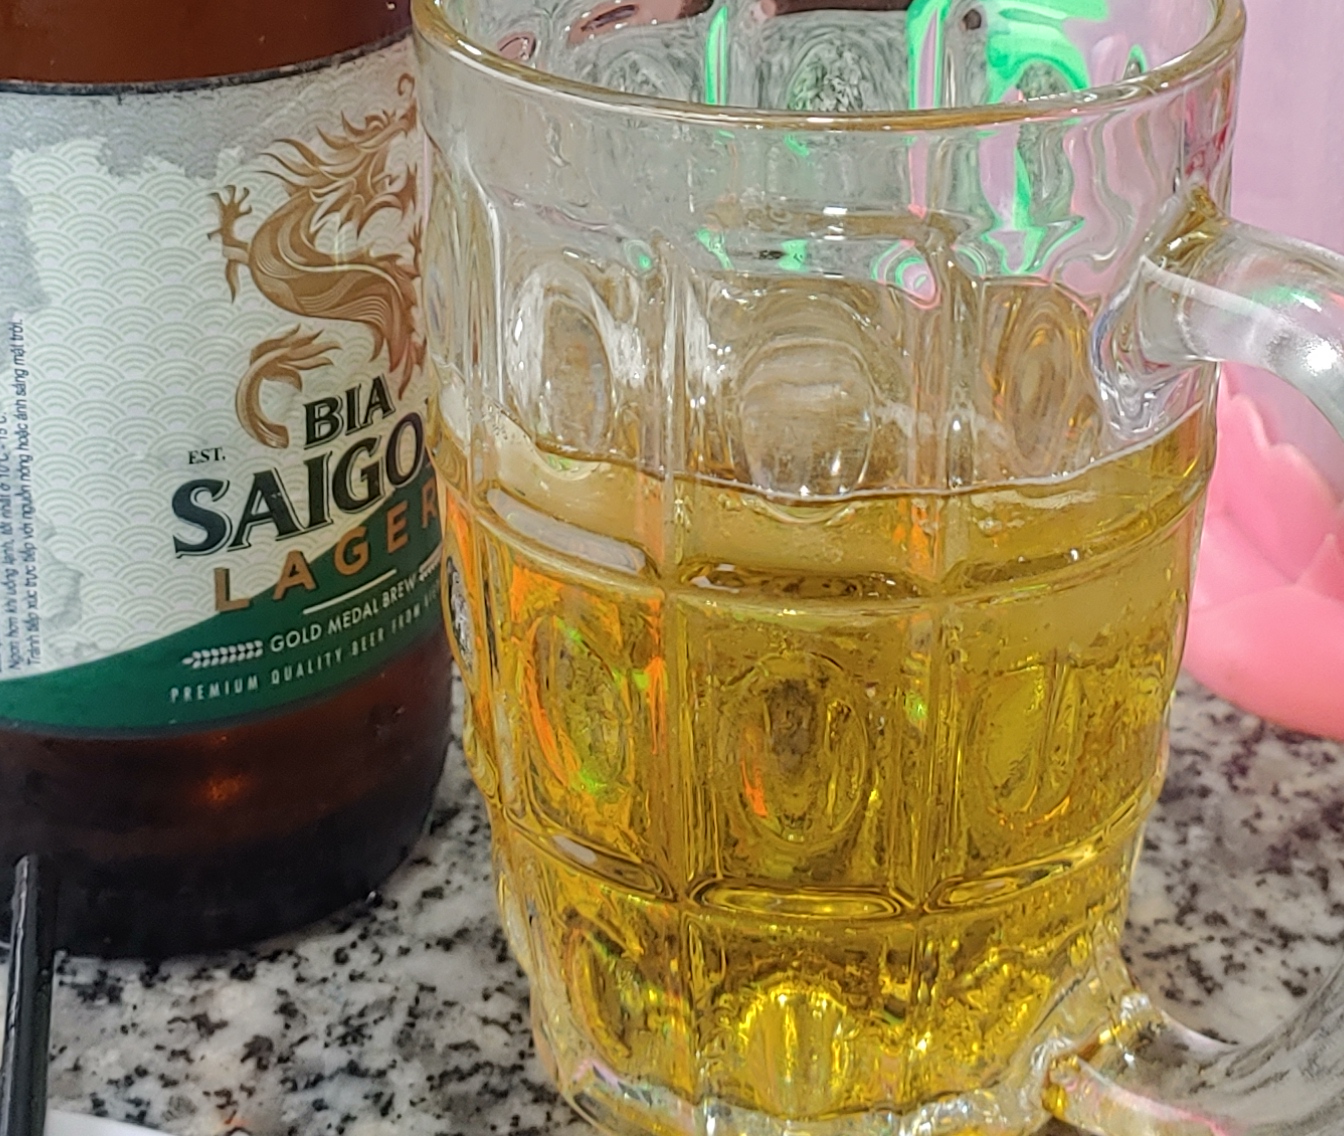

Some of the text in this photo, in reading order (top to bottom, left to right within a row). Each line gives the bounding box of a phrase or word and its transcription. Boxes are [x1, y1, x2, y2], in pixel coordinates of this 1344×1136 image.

[303, 374, 396, 451] BIA
[171, 411, 425, 559] SAIGO
[188, 446, 226, 464] EST.
[213, 476, 439, 612] LAGER
[270, 623, 322, 653] GOLD
[327, 598, 379, 636] MEDAL
[170, 675, 259, 703] PREMIUM
[271, 648, 343, 685] QUALITY
